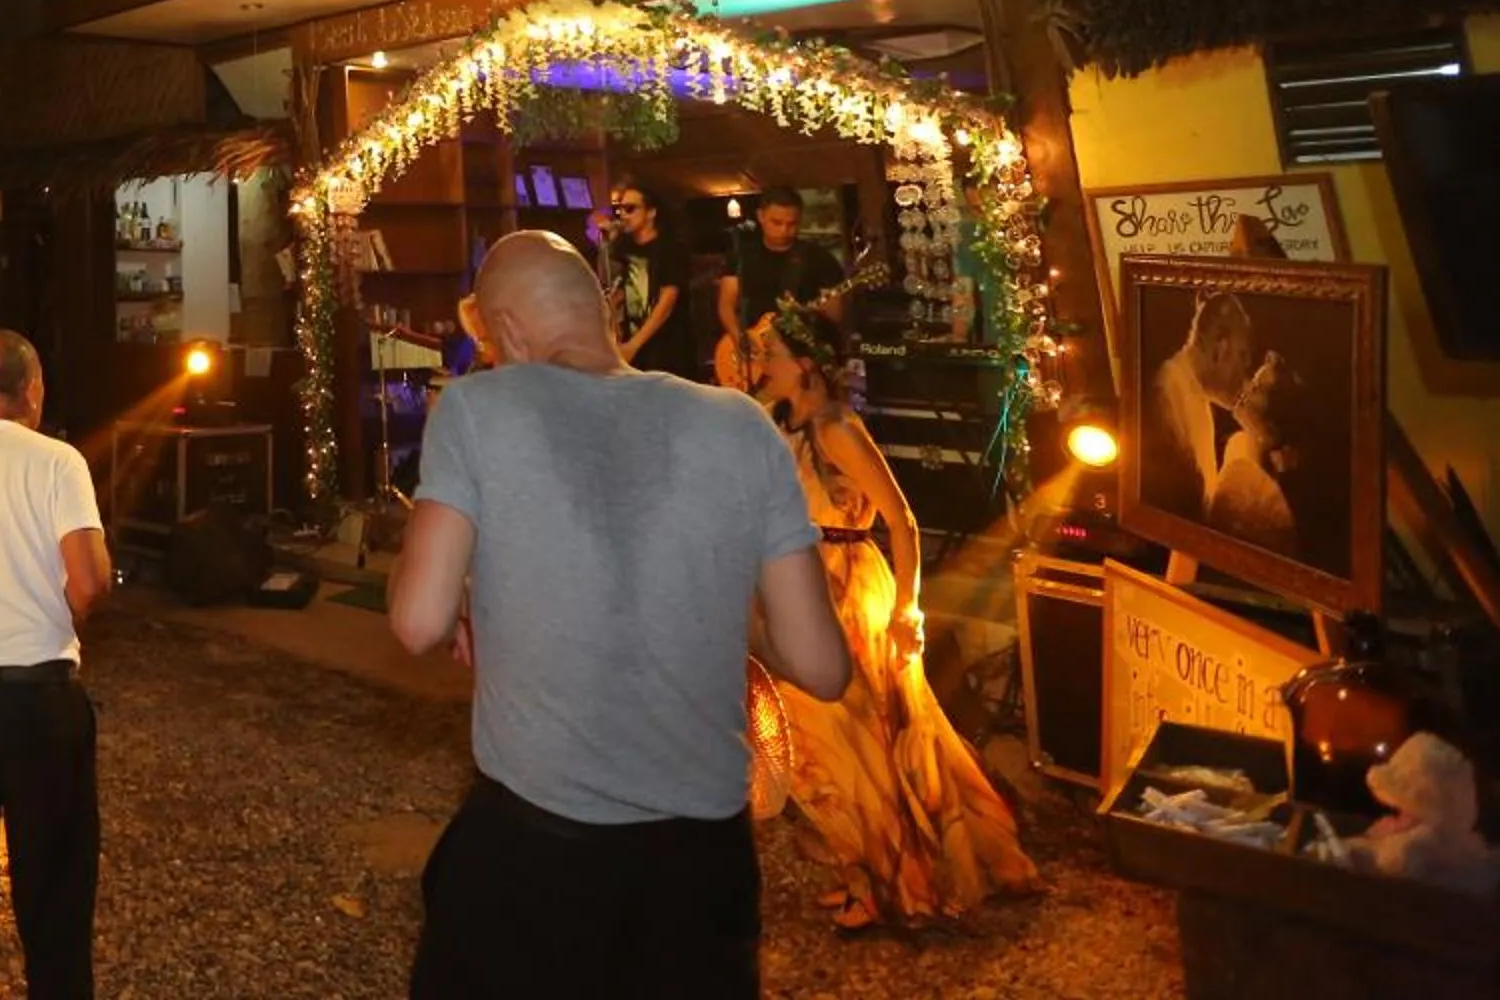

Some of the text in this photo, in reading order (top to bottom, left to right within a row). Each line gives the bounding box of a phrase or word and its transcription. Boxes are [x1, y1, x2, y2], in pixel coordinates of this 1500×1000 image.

[1111, 195, 1193, 237] Share
[860, 343, 907, 357] Roland
[1176, 642, 1229, 703] once
